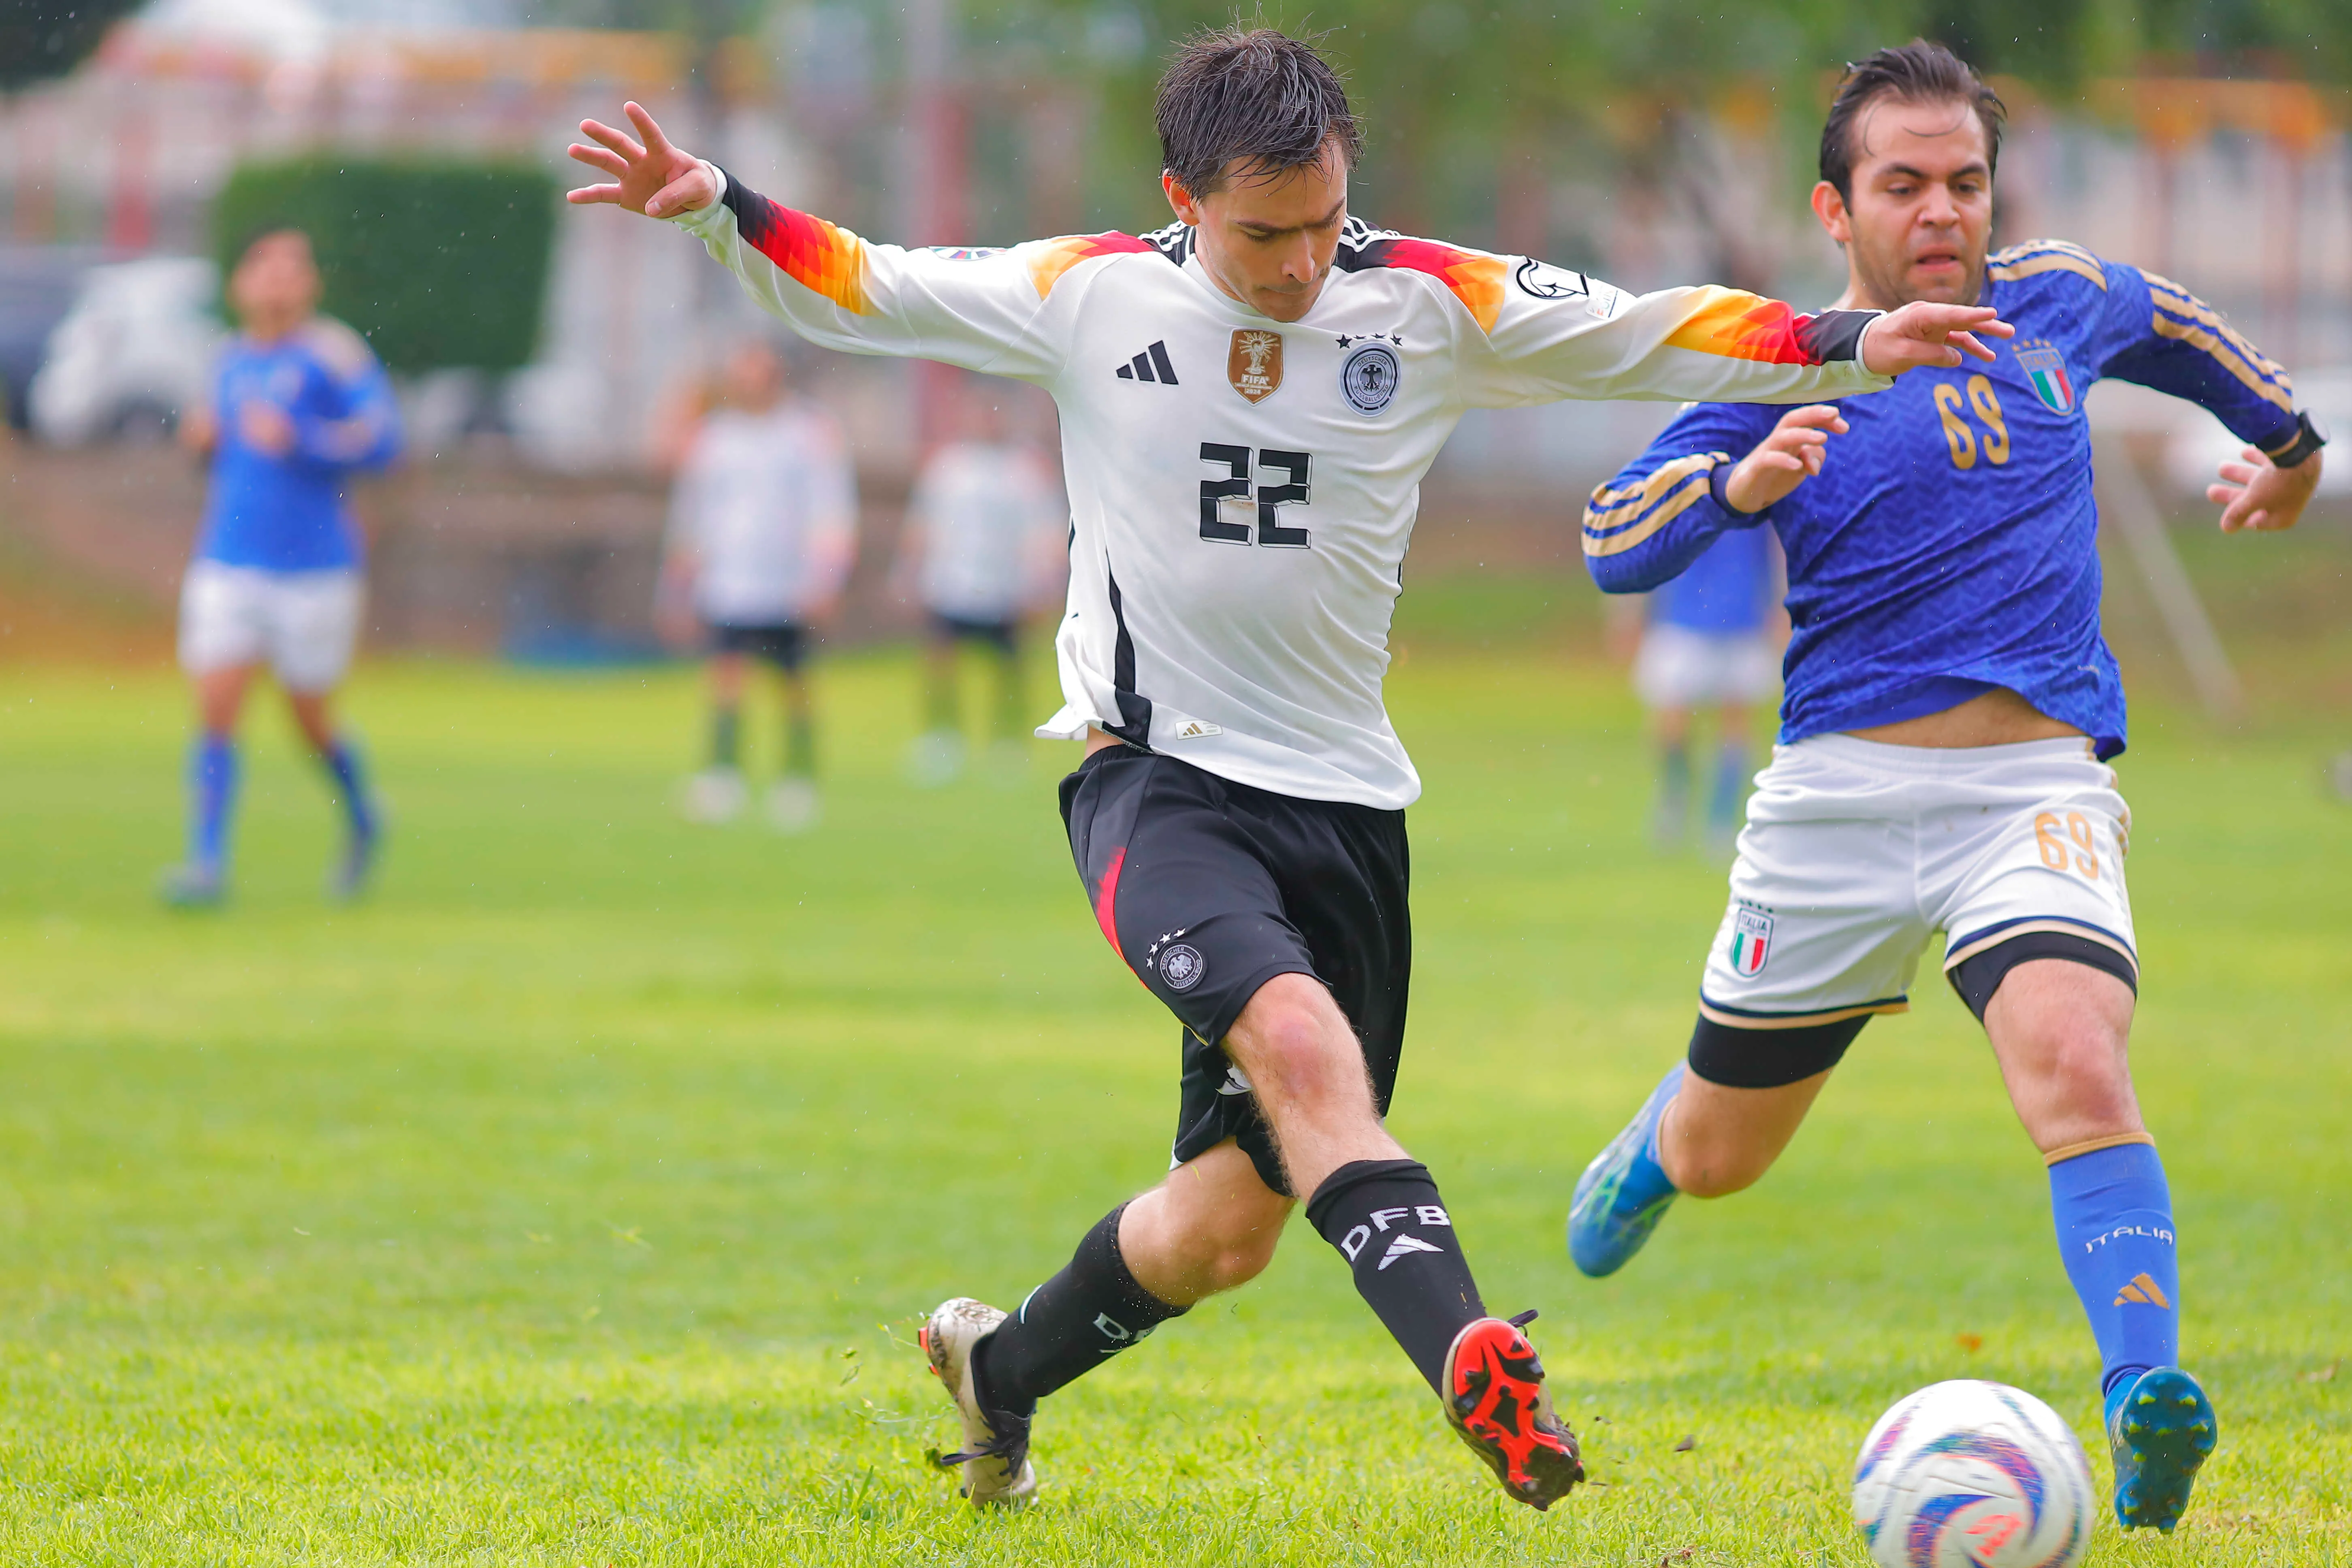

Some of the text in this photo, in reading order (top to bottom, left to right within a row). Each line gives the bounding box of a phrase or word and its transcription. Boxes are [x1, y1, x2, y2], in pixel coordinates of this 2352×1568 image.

[1357, 356, 1388, 367] DEUTSCHER
[1354, 384, 1388, 402] FUSSBALL-BUND
[1933, 374, 2010, 470] 69
[1200, 442, 1313, 549] 22
[2034, 812, 2099, 880] 69
[1742, 914, 1768, 931] ITALIA
[1162, 946, 1185, 970] DEUTSCHER
[1173, 959, 1201, 987] FUSSBALL-BUND
[1340, 1205, 1451, 1263] DFB
[2085, 1225, 2173, 1254] ITALIA
